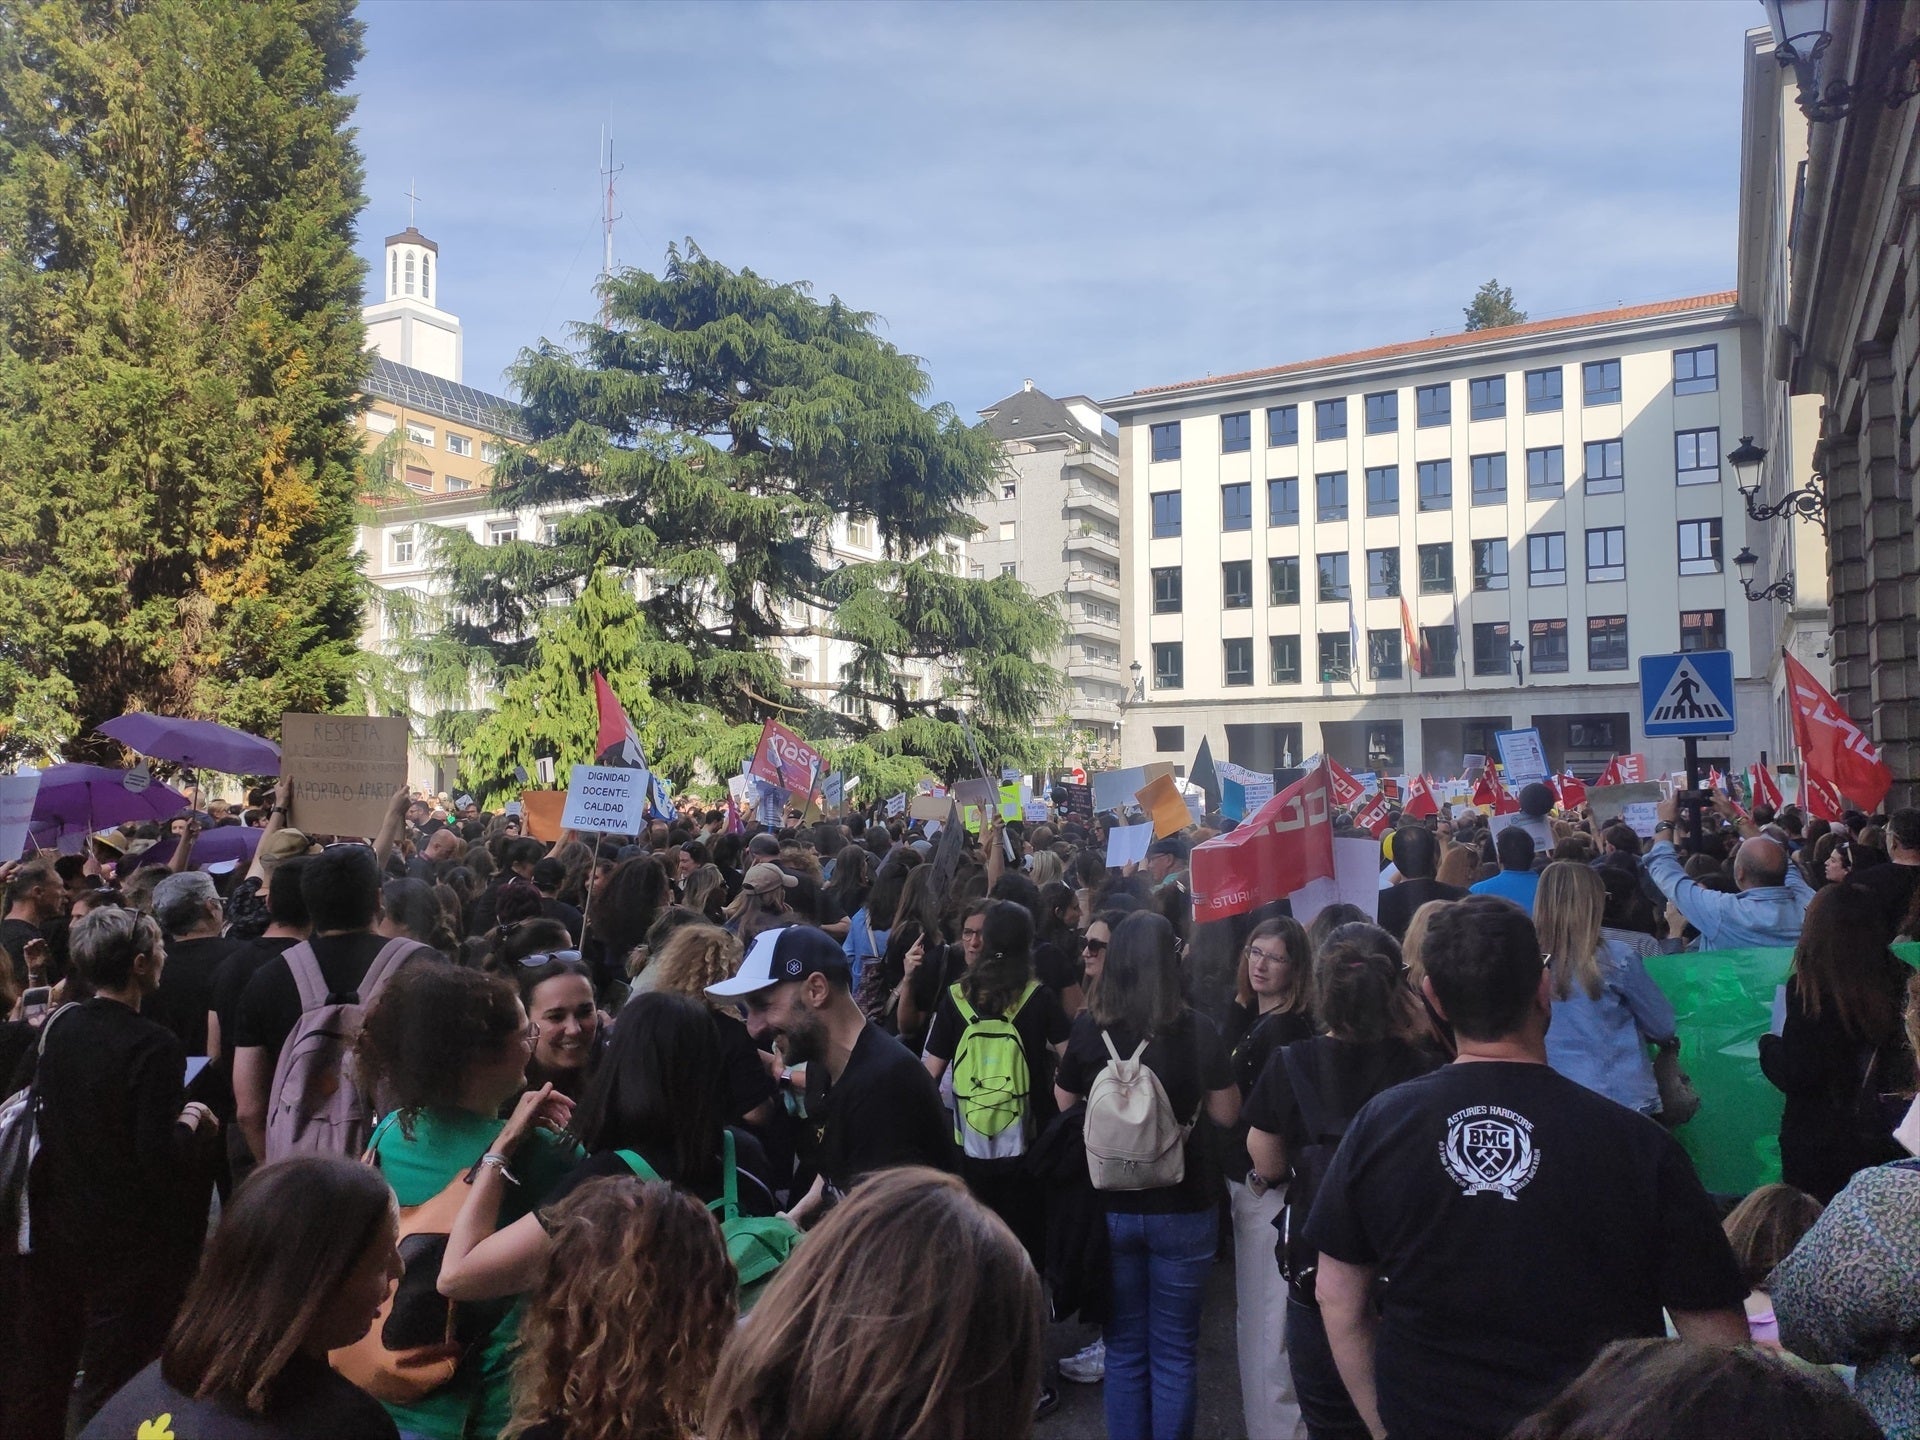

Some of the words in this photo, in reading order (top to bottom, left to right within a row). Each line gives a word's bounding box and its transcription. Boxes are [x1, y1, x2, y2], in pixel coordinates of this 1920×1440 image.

[313, 722, 380, 742] RESPETA
[587, 771, 631, 783] DIGNIDAD
[297, 781, 341, 801] APORTA
[342, 785, 353, 801] O
[583, 801, 624, 813] CALIDAD
[573, 815, 628, 829] EDUCATIVA
[1446, 1105, 1488, 1127] ASTURIES
[1489, 1105, 1535, 1133] HARDCORE
[1468, 1129, 1510, 1147] BMC
